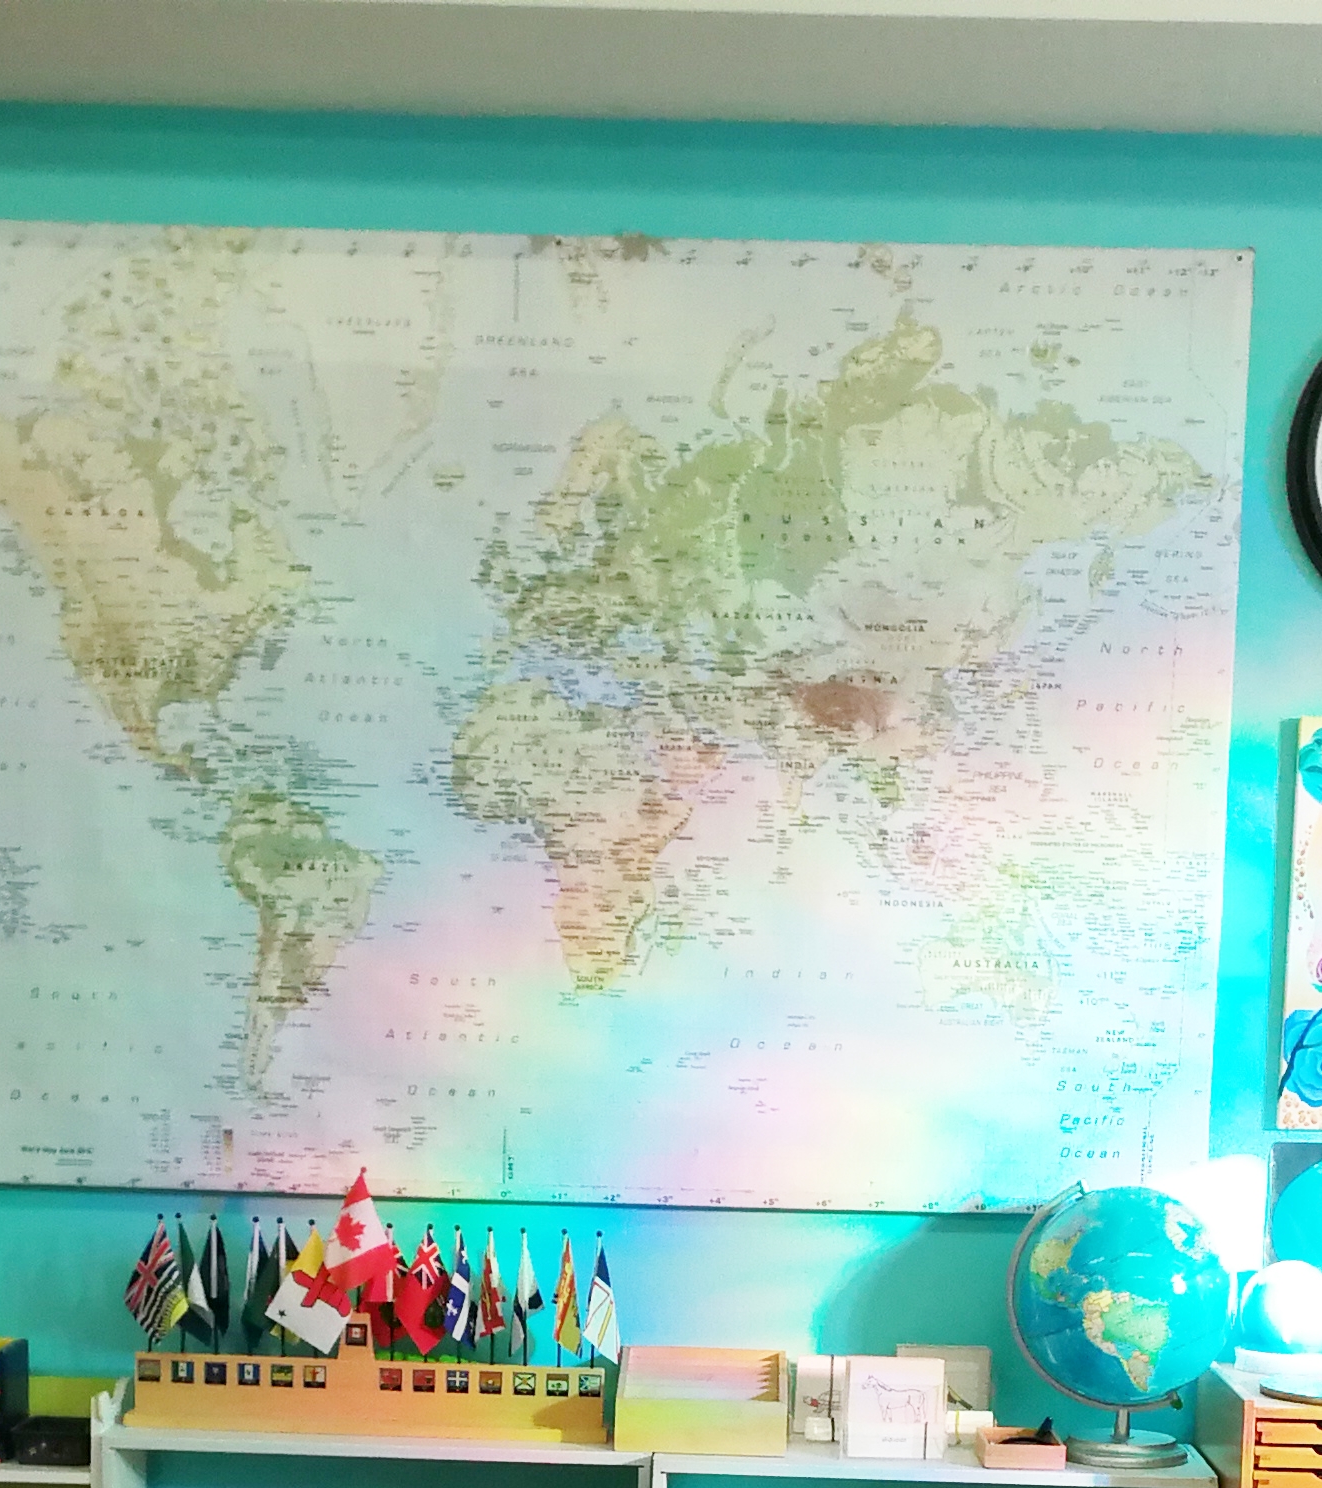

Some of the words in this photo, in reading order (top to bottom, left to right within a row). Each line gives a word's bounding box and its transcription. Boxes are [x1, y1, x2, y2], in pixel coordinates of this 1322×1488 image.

[742, 512, 986, 530] RUSSIAN
[864, 623, 925, 632] MONGOLIA
[1100, 642, 1184, 656] North
[1077, 699, 1186, 714] Pacific
[780, 761, 816, 770] INDIA
[1094, 756, 1179, 771] Ocean
[879, 899, 944, 909] INDONESIA
[953, 959, 1039, 969] AUSTRALIA
[410, 972, 497, 987] South
[723, 967, 855, 981] Indian
[385, 1027, 520, 1044] Atlantic
[729, 1036, 844, 1052] Ocean
[407, 1083, 497, 1099] Ocean
[1056, 1080, 1132, 1093] South
[1060, 1112, 1125, 1127] Pacific
[1060, 1146, 1120, 1159] Ocean
